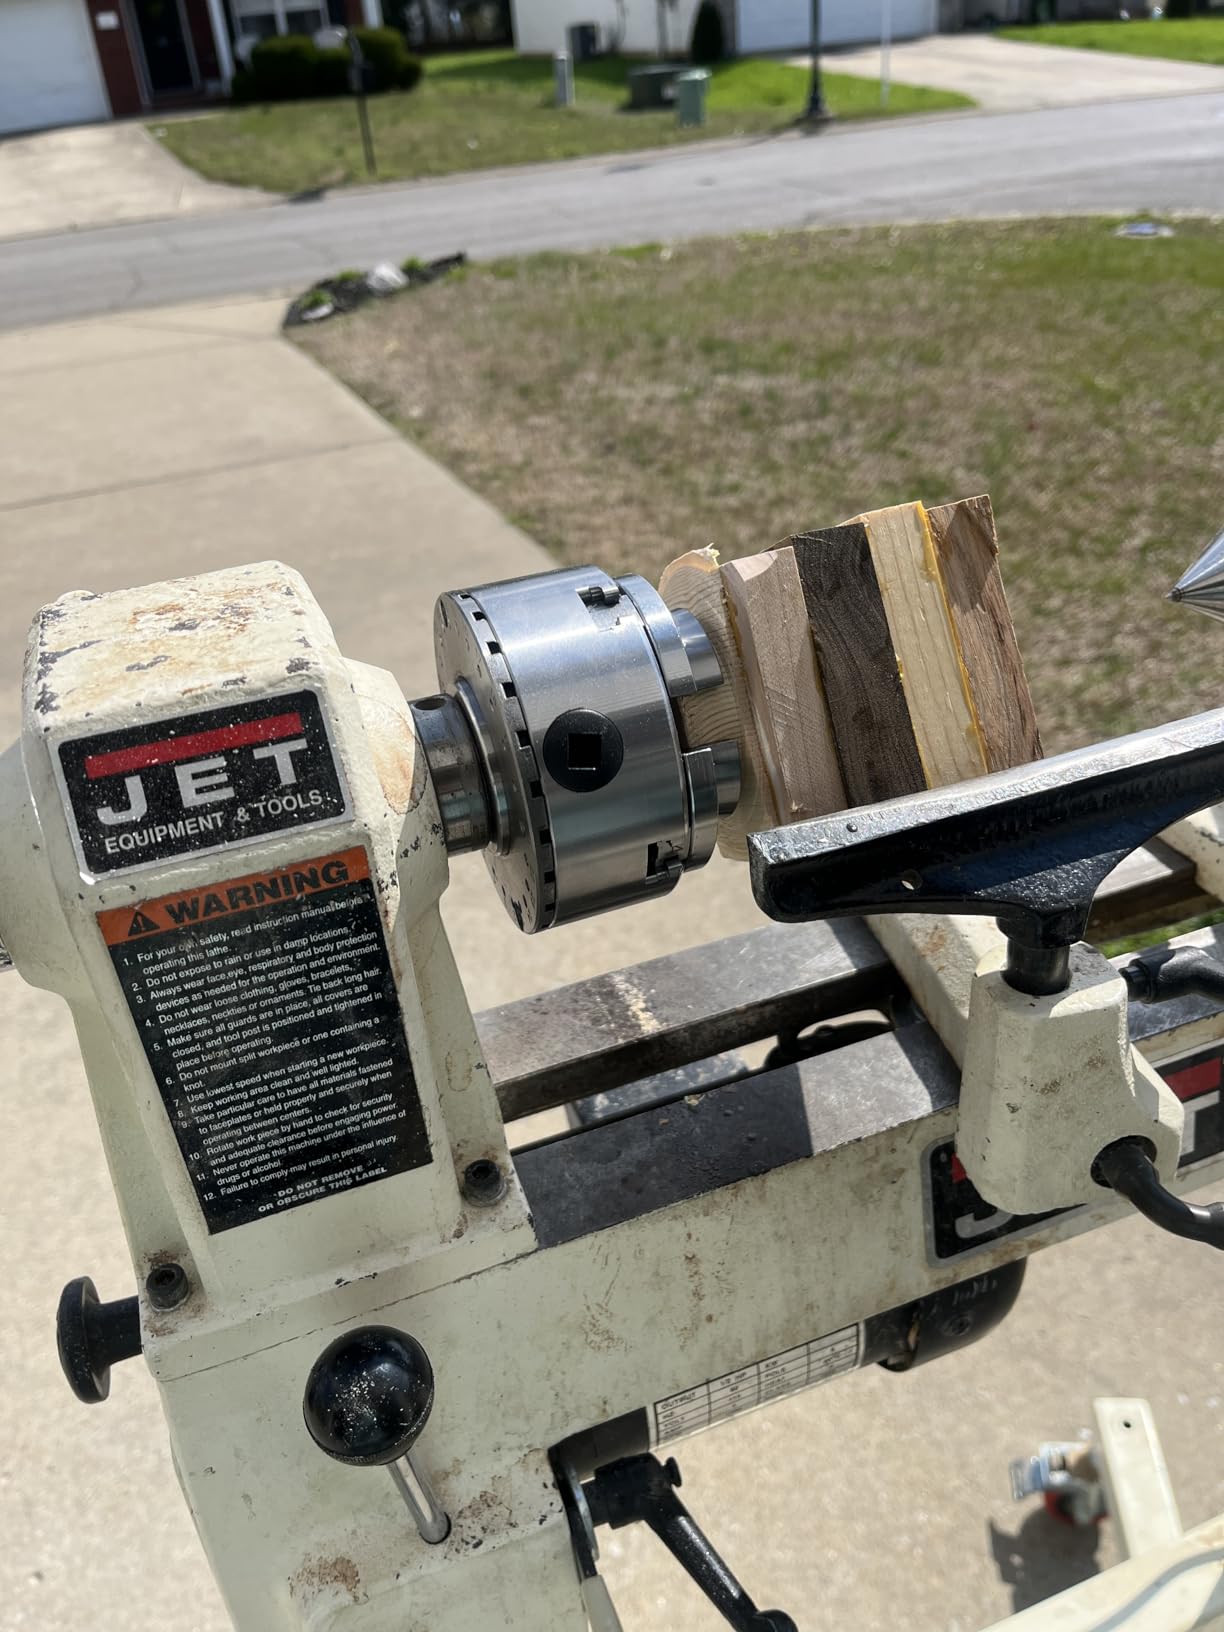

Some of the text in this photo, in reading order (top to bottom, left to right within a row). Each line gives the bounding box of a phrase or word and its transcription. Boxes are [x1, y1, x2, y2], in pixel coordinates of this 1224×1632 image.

[97, 738, 307, 825] JET
[105, 788, 323, 855] EQUIPMENT & TOOLS
[167, 860, 350, 924] WARNING
[137, 952, 153, 963] For
[155, 946, 176, 959] your
[199, 932, 230, 946] safety,
[231, 924, 252, 937] read
[254, 914, 300, 931] instruction
[142, 946, 231, 975] operating this lathe.
[146, 927, 351, 987] Do not expose to rain use damp locations.
[150, 985, 182, 1000] Always
[183, 978, 204, 990] wear
[248, 954, 293, 972] respiratory
[296, 948, 312, 959] and
[313, 943, 334, 954] body
[336, 932, 377, 950] protection
[155, 943, 380, 1011] devices needed for the operation and environment.
[158, 964, 353, 1023] Do not wear loose clothing, gloves, bracelets,
[164, 967, 382, 1035] necklaces, neckties ornaments. Tie back long hair.
[167, 984, 368, 1047] Make sure all guards are place, all covers are
[172, 993, 373, 1058] closed, and tool post positioned and tightened
[176, 1036, 274, 1071] place before operating.
[179, 1019, 373, 1081] Do not mount split workpiece one containing
[186, 1035, 389, 1103] Use lowest speed when starting new workpiece.
[183, 1080, 206, 1092] knot.
[190, 1057, 359, 1114] Keep working area clean and well lighted.
[194, 1113, 215, 1124] Take
[216, 1101, 255, 1119] particular
[256, 1095, 276, 1105] care
[286, 1085, 307, 1096] have
[309, 1080, 319, 1089] all
[320, 1070, 357, 1086] materials
[358, 1058, 393, 1074] fastened
[209, 1113, 252, 1131] faceplates
[263, 1103, 282, 1115] held
[283, 1094, 316, 1110] properly
[318, 1087, 334, 1098] and
[335, 1078, 368, 1093] securely
[370, 1071, 392, 1082] when
[202, 1107, 312, 1146] operating between centers.
[206, 1142, 234, 1156] Rotate
[236, 1134, 256, 1146] work
[257, 1128, 279, 1141] piece
[292, 1116, 314, 1128] hand
[324, 1106, 348, 1119] check
[349, 1103, 360, 1111] for
[362, 1093, 392, 1107] security
[210, 1102, 398, 1166] and adequate clearance before engaging power.
[213, 1109, 406, 1176] Never operate this machine under the influence of
[217, 1174, 241, 1186] drugs
[220, 1182, 249, 1196] Failure
[260, 1169, 288, 1183] comply
[289, 1163, 307, 1173] may
[308, 1155, 331, 1167] result
[341, 1140, 374, 1158] personal
[376, 1135, 398, 1146] injury.
[258, 1167, 387, 1212] OR OBSCURE THIS LABEL
[277, 1165, 363, 1197] DO NOT REMOVE
